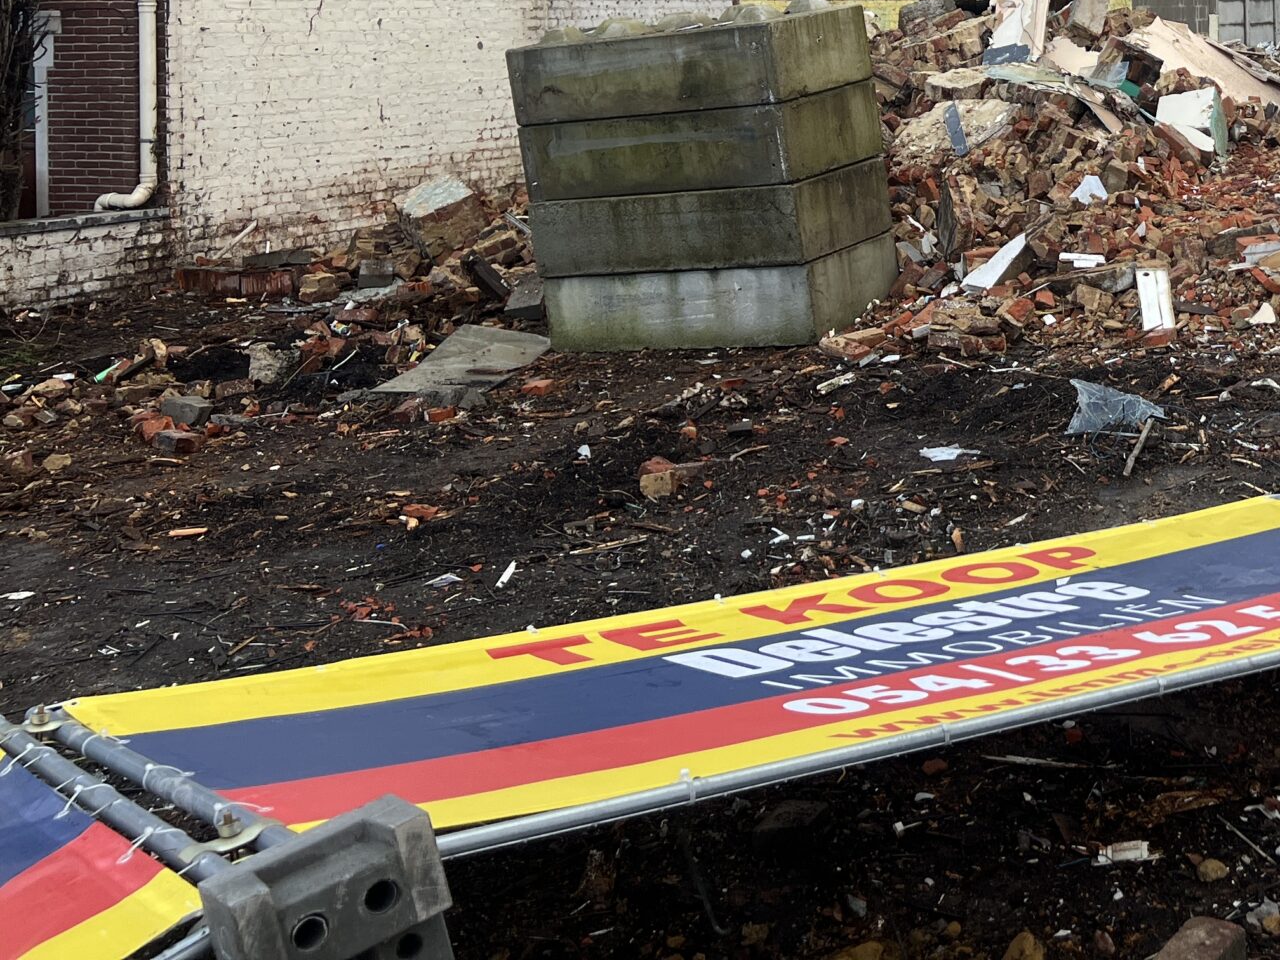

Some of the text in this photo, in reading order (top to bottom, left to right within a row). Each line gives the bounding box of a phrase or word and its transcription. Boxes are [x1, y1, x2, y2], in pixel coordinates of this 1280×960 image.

[486, 546, 1097, 666] TE KOOP
[661, 576, 1151, 679] Delestré
[760, 594, 1227, 690] IMMOBILIËN
[1133, 619, 1265, 644] 62
